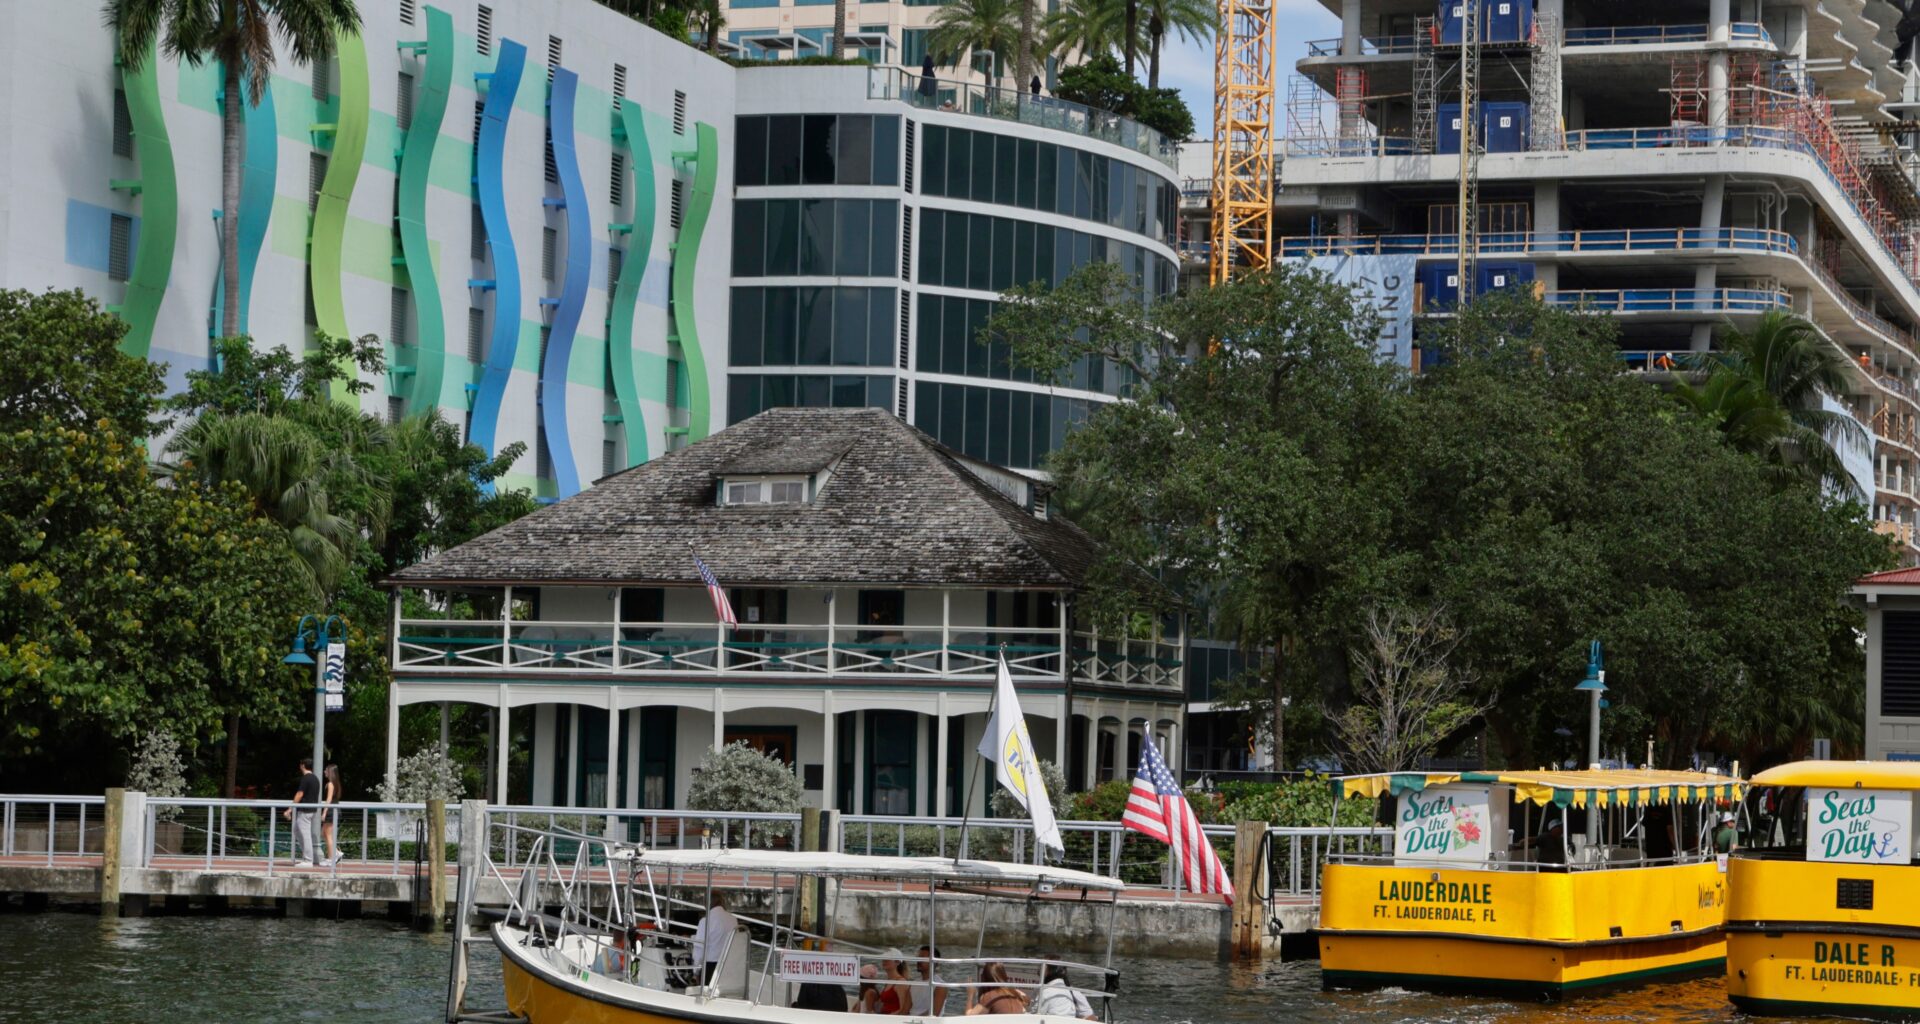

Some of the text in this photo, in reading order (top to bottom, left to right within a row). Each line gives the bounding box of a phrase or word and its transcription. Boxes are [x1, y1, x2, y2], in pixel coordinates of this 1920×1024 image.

[1402, 791, 1453, 822] Seas
[1819, 790, 1875, 824] Seas
[1428, 817, 1448, 832] the
[1849, 818, 1870, 834] the
[1404, 826, 1452, 854] Day
[1821, 828, 1875, 859] Day
[1379, 880, 1491, 904] LAUDERDALE
[1373, 905, 1496, 922] FT. LAUDERDALE, FL
[1814, 941, 1895, 967] DALE R
[784, 960, 856, 976] FREE WATER TROLLEY
[1785, 965, 1805, 980] FT.
[1909, 973, 1920, 987] F
